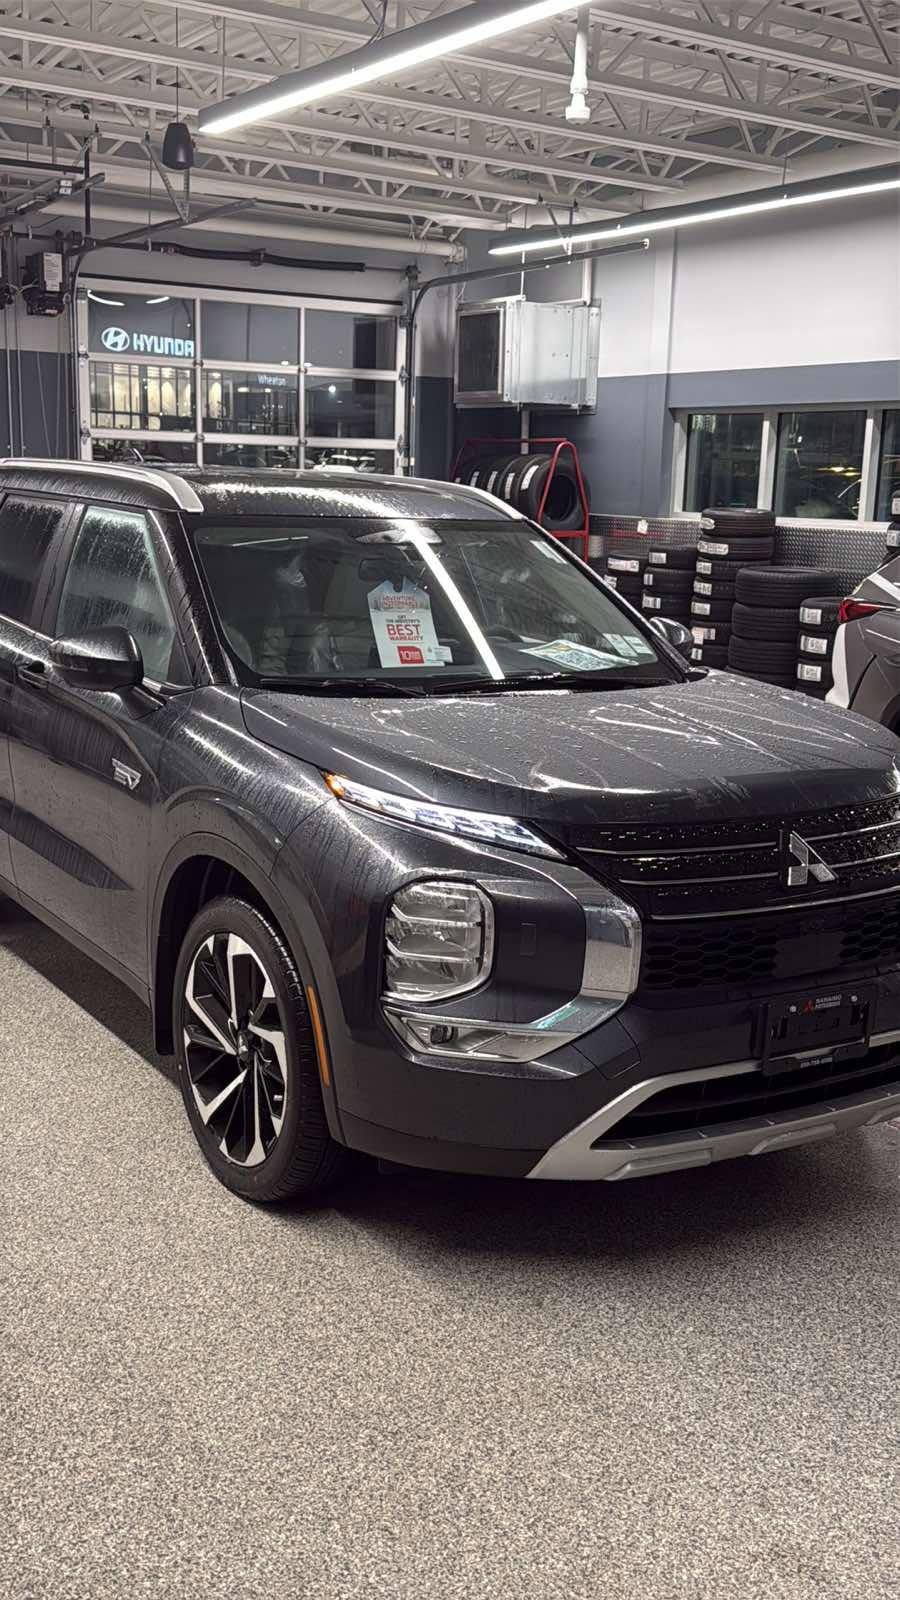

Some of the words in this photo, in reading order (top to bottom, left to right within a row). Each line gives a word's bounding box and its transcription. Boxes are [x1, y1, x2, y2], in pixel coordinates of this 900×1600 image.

[133, 333, 194, 357] HYUNDA
[258, 374, 287, 385] Wheaton
[386, 624, 421, 636] BEST
[400, 650, 411, 660] 10
